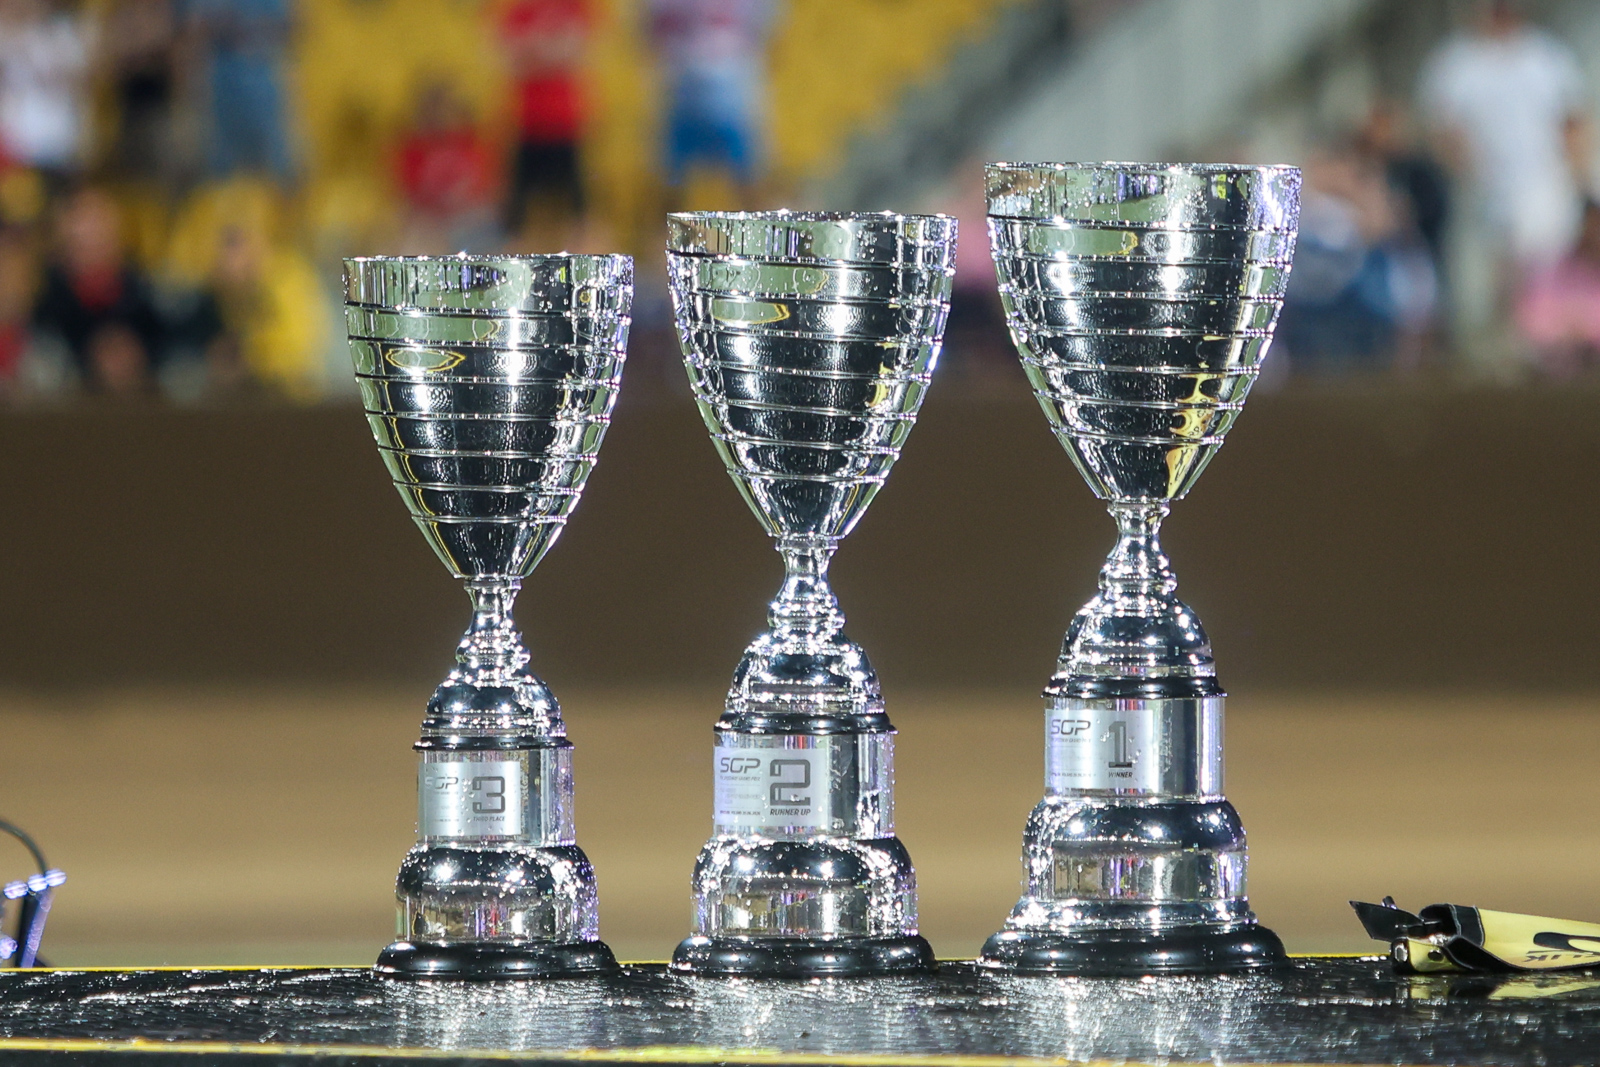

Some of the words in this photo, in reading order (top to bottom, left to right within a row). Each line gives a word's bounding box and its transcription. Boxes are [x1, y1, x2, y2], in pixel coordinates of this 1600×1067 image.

[1050, 719, 1091, 735] SGP
[1108, 720, 1133, 768] 1
[720, 757, 761, 774] SGP
[472, 775, 506, 814] 3
[769, 758, 811, 806] 2
[769, 808, 800, 816] RUNNER
[801, 808, 811, 816] UP
